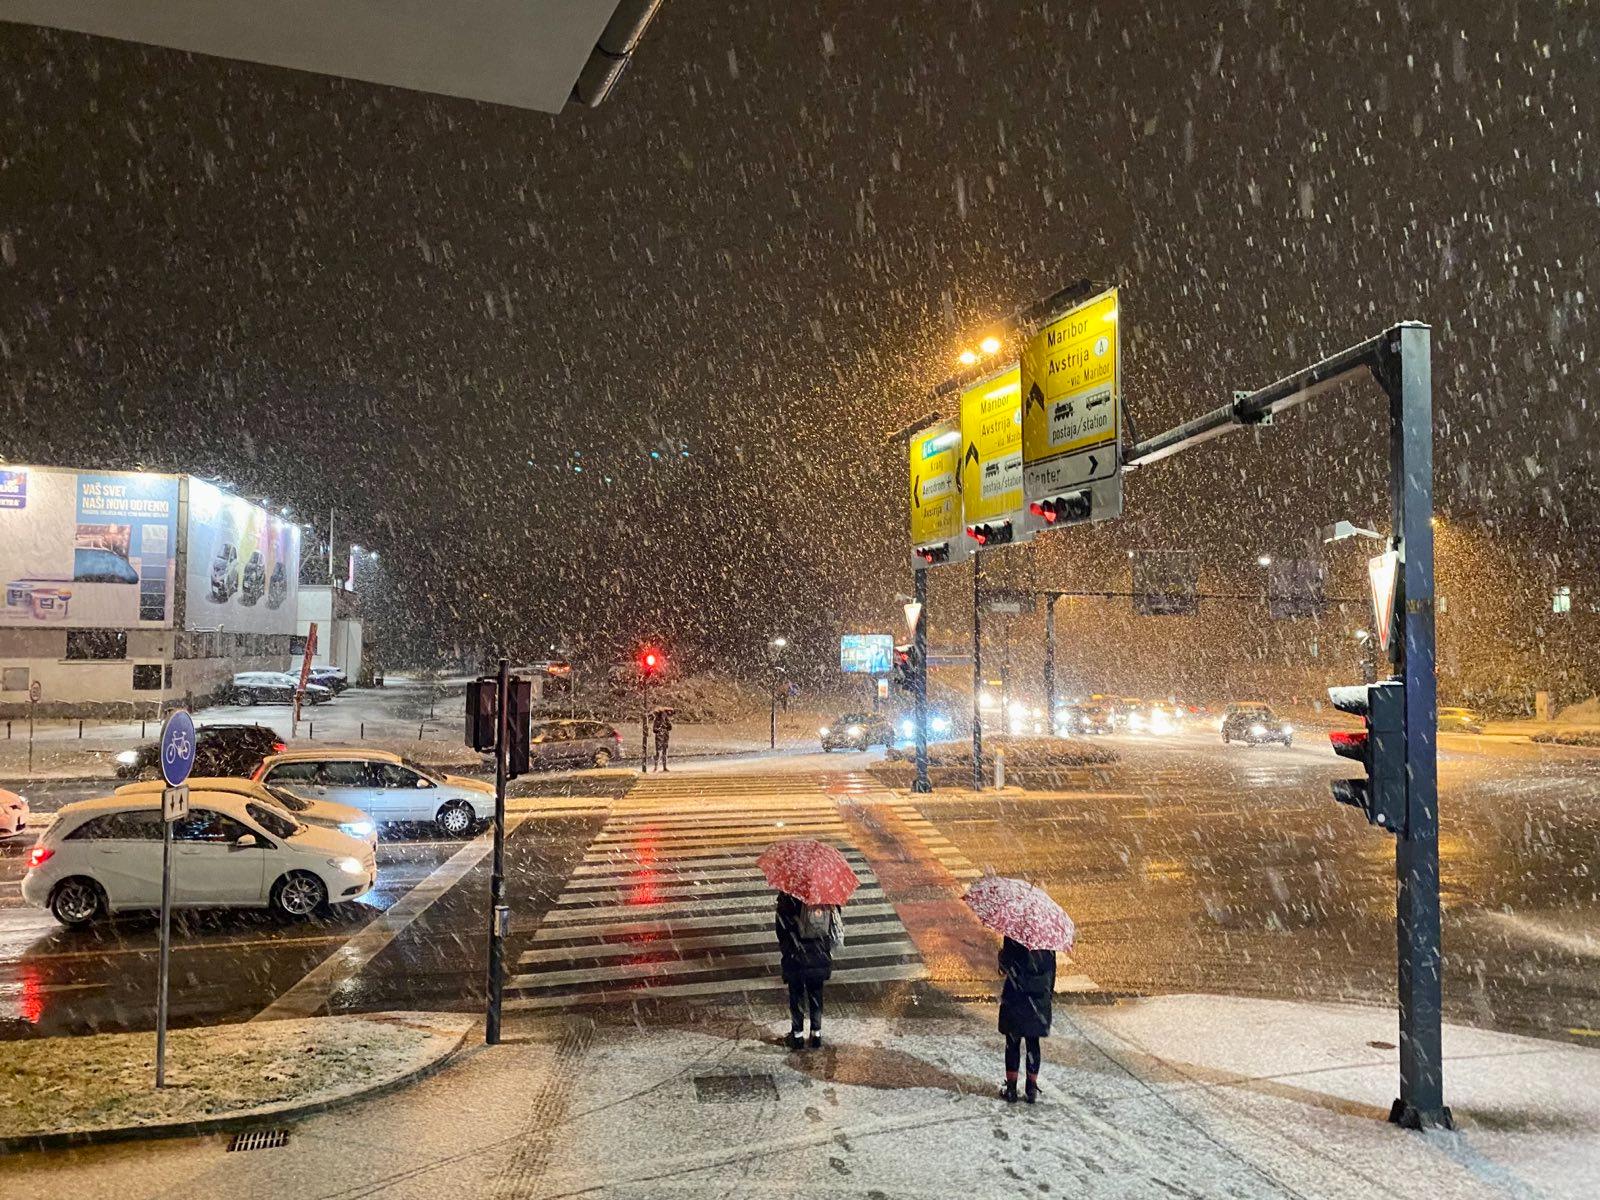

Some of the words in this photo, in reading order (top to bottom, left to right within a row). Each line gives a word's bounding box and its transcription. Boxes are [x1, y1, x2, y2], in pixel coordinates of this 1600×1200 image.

[1047, 320, 1088, 348] Maribor
[1048, 347, 1090, 376] Avstrija
[1083, 361, 1110, 381] Maribor
[980, 394, 1009, 415] Maribor
[981, 415, 1011, 437] Avstrija
[1028, 468, 1061, 485] Center
[83, 482, 102, 495] VAŠ
[103, 484, 127, 497] SVET
[82, 496, 104, 509] NAŠI
[106, 498, 128, 510] NOVI
[130, 500, 169, 513] ODTENKI
